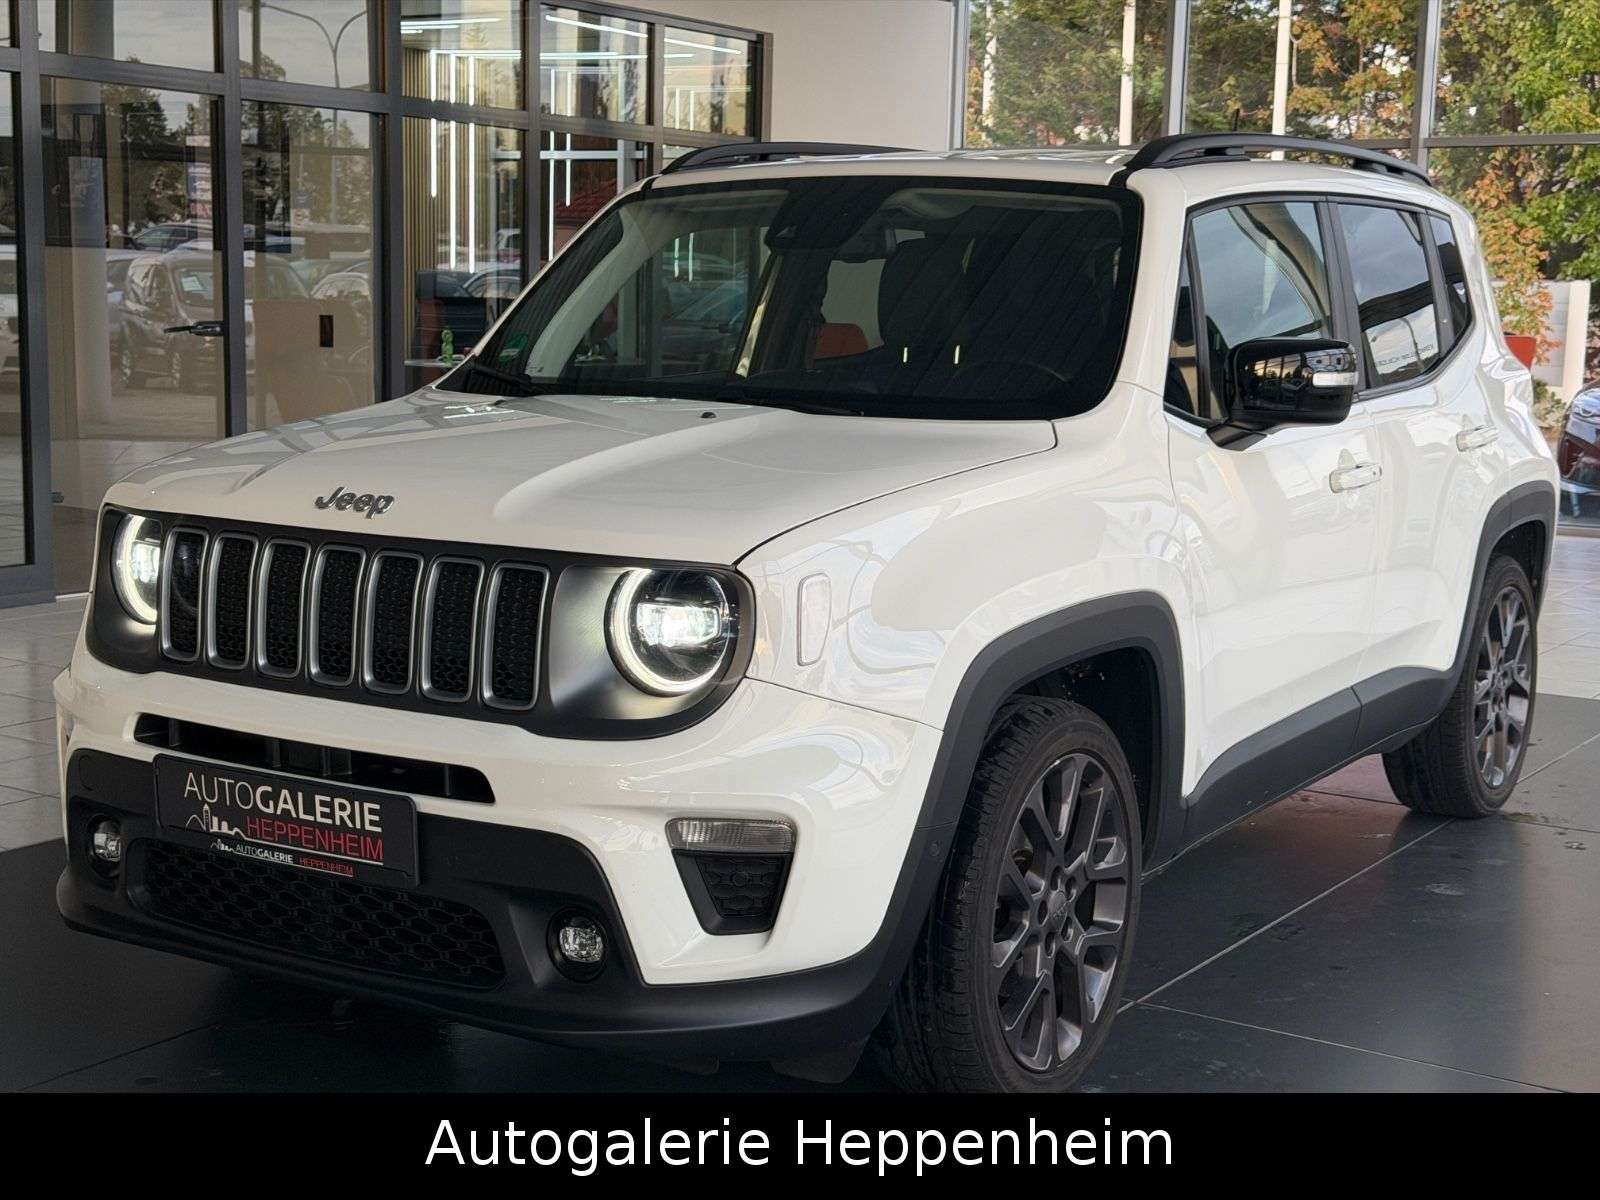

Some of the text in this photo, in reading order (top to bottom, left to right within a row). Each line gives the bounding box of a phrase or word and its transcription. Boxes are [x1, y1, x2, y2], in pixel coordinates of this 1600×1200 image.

[315, 486, 395, 519] Jeep
[183, 771, 382, 833] AUTOGALERIE
[246, 815, 384, 861] HEPPENHEIM
[236, 844, 354, 876] AUTOGALERIE HEPPENHEIM
